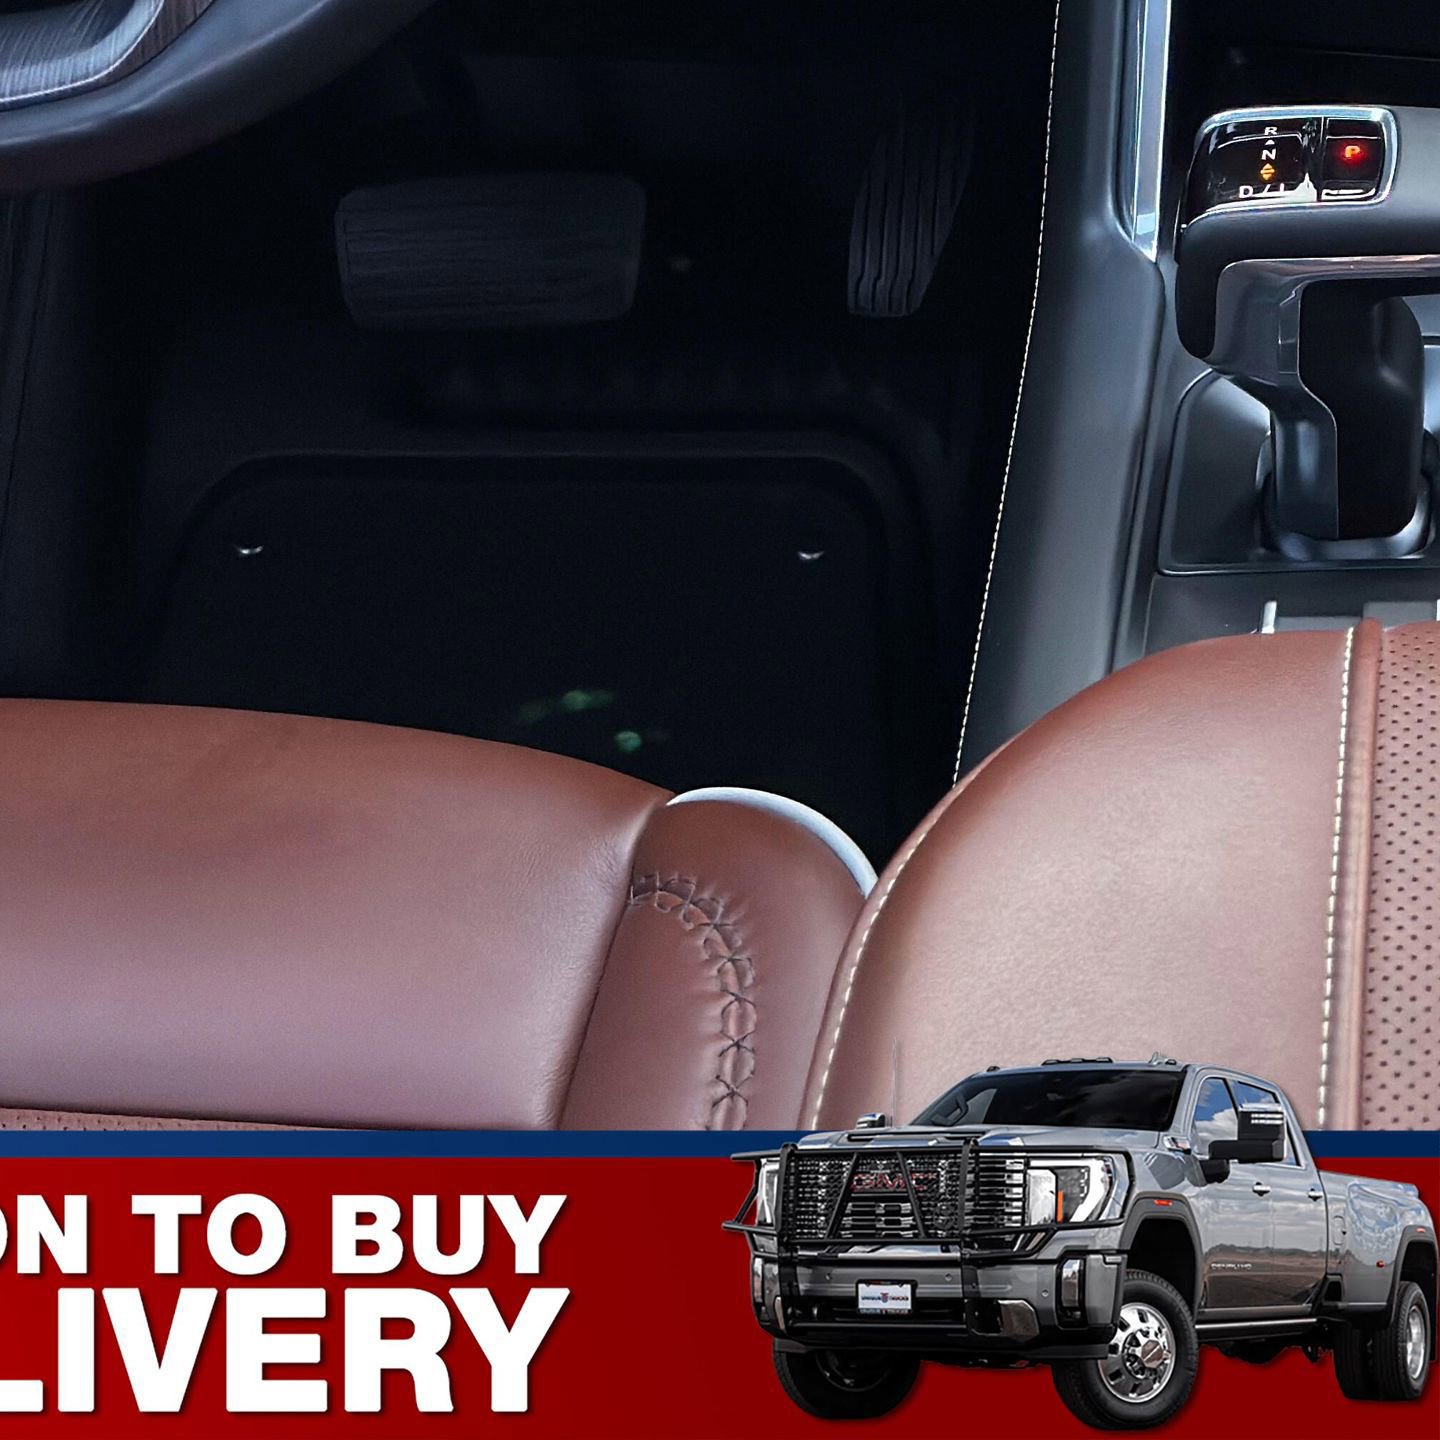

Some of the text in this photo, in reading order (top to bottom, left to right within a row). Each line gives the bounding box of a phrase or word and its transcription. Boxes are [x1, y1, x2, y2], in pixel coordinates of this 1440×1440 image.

[1264, 126, 1278, 136] R
[1261, 148, 1277, 161] N
[1344, 145, 1361, 158] P
[1238, 185, 1254, 199] D
